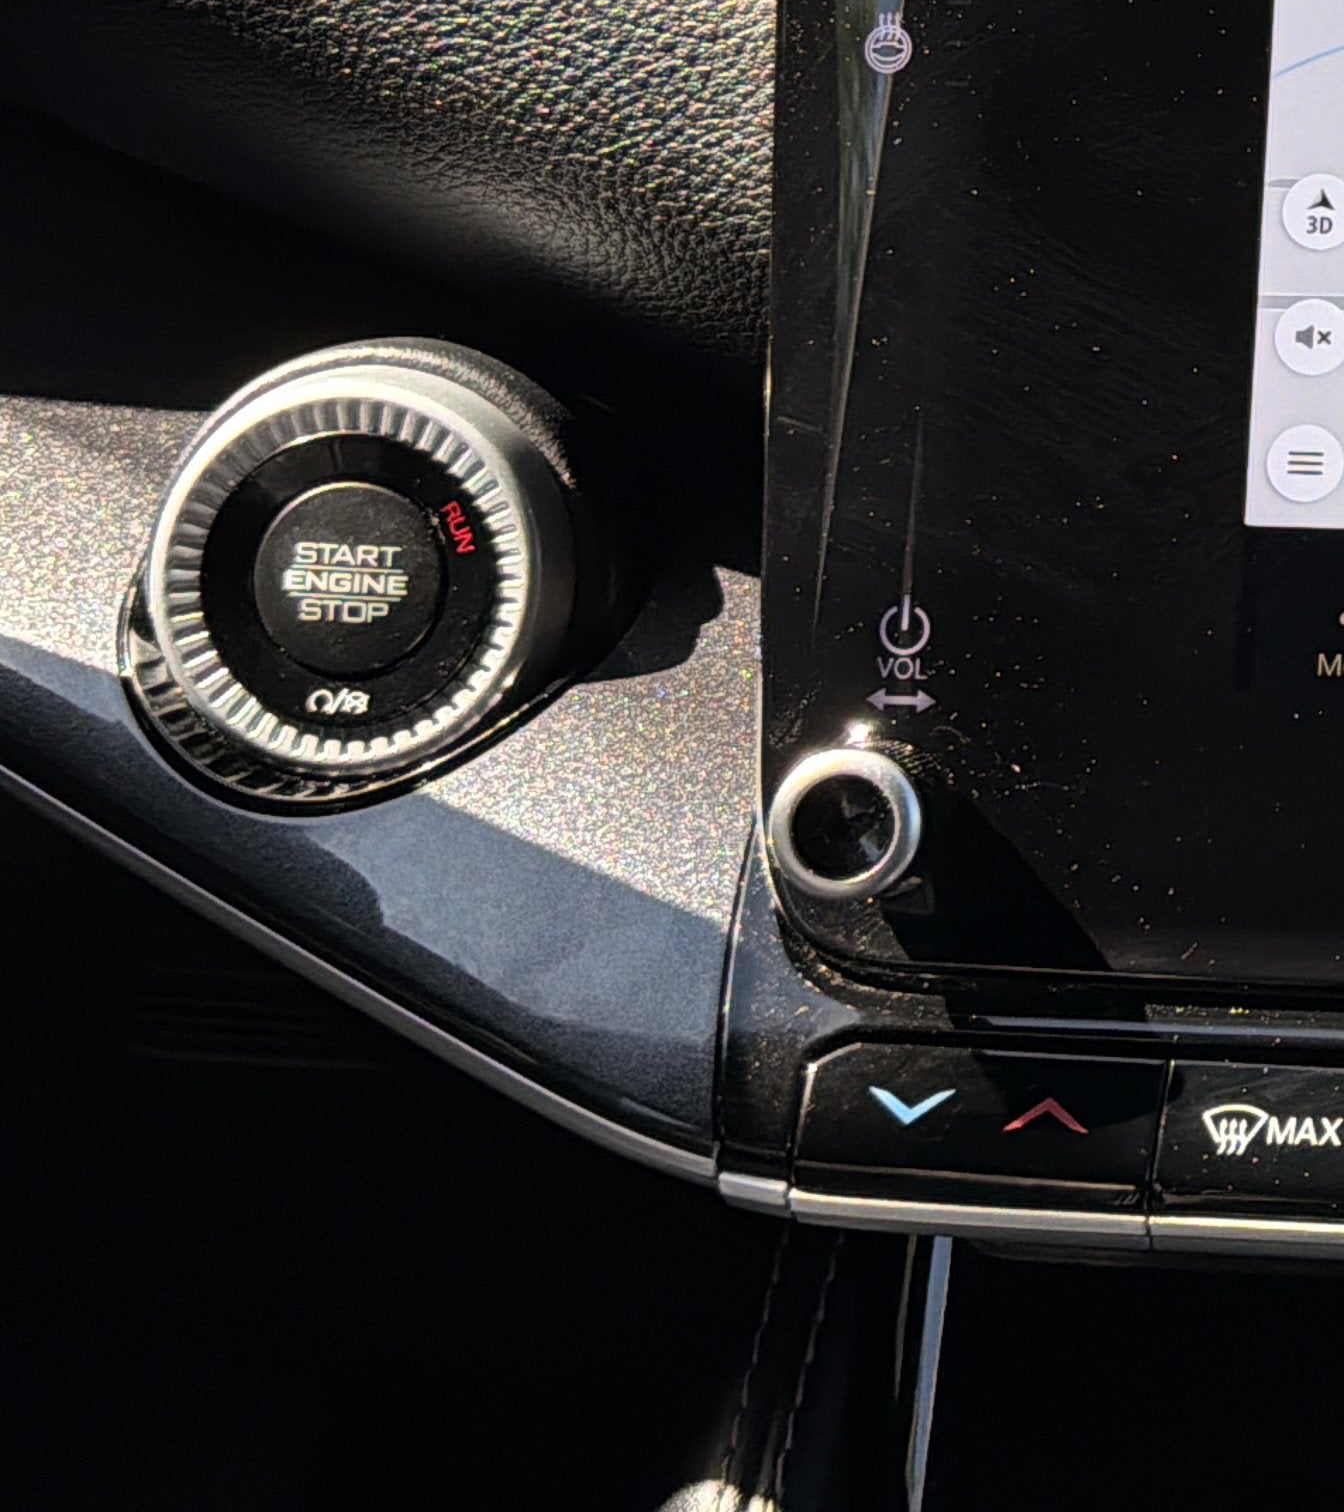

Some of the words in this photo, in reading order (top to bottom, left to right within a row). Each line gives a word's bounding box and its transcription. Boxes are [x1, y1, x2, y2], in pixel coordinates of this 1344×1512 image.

[1306, 216, 1332, 234] 3D
[440, 501, 475, 555] RUN
[295, 542, 401, 565] START
[283, 571, 408, 594] ENGINE
[299, 600, 389, 622] STOP
[877, 657, 928, 679] VOL
[1265, 1115, 1341, 1147] MAX
